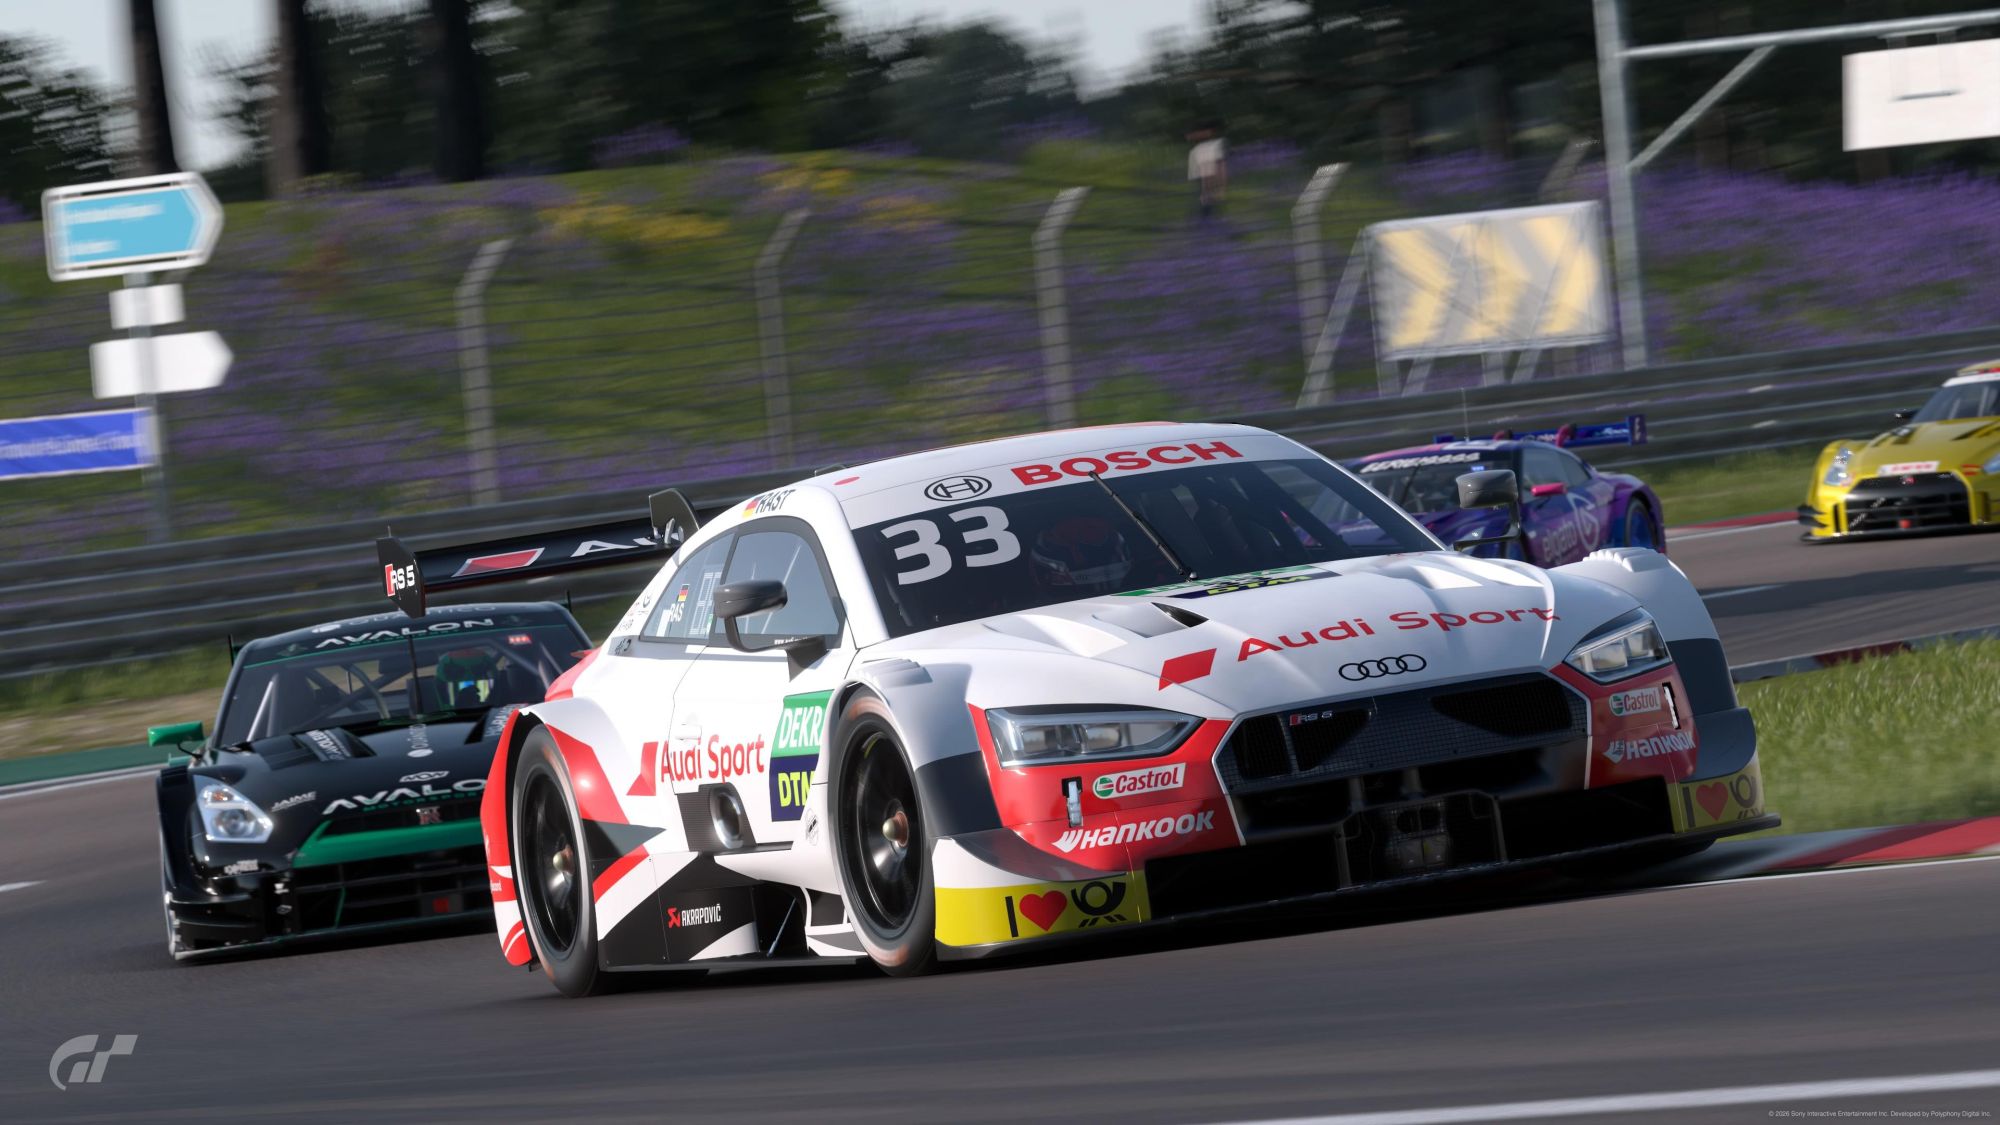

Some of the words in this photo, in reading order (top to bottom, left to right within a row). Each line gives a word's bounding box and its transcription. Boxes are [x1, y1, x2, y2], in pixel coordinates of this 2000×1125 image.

[1011, 441, 1243, 485] BOSCH
[756, 489, 796, 514] RAST
[880, 506, 1021, 585] 33
[315, 618, 495, 648] AVALON
[1238, 618, 1375, 662] Audi
[1388, 606, 1562, 632] Sport
[1623, 690, 1660, 712] Castrol
[660, 737, 702, 783] Audi
[707, 734, 765, 784] Sport
[322, 778, 488, 815] AVALO
[1113, 766, 1180, 795] Castrol
[1682, 786, 1696, 828] I
[1005, 895, 1019, 938] I
